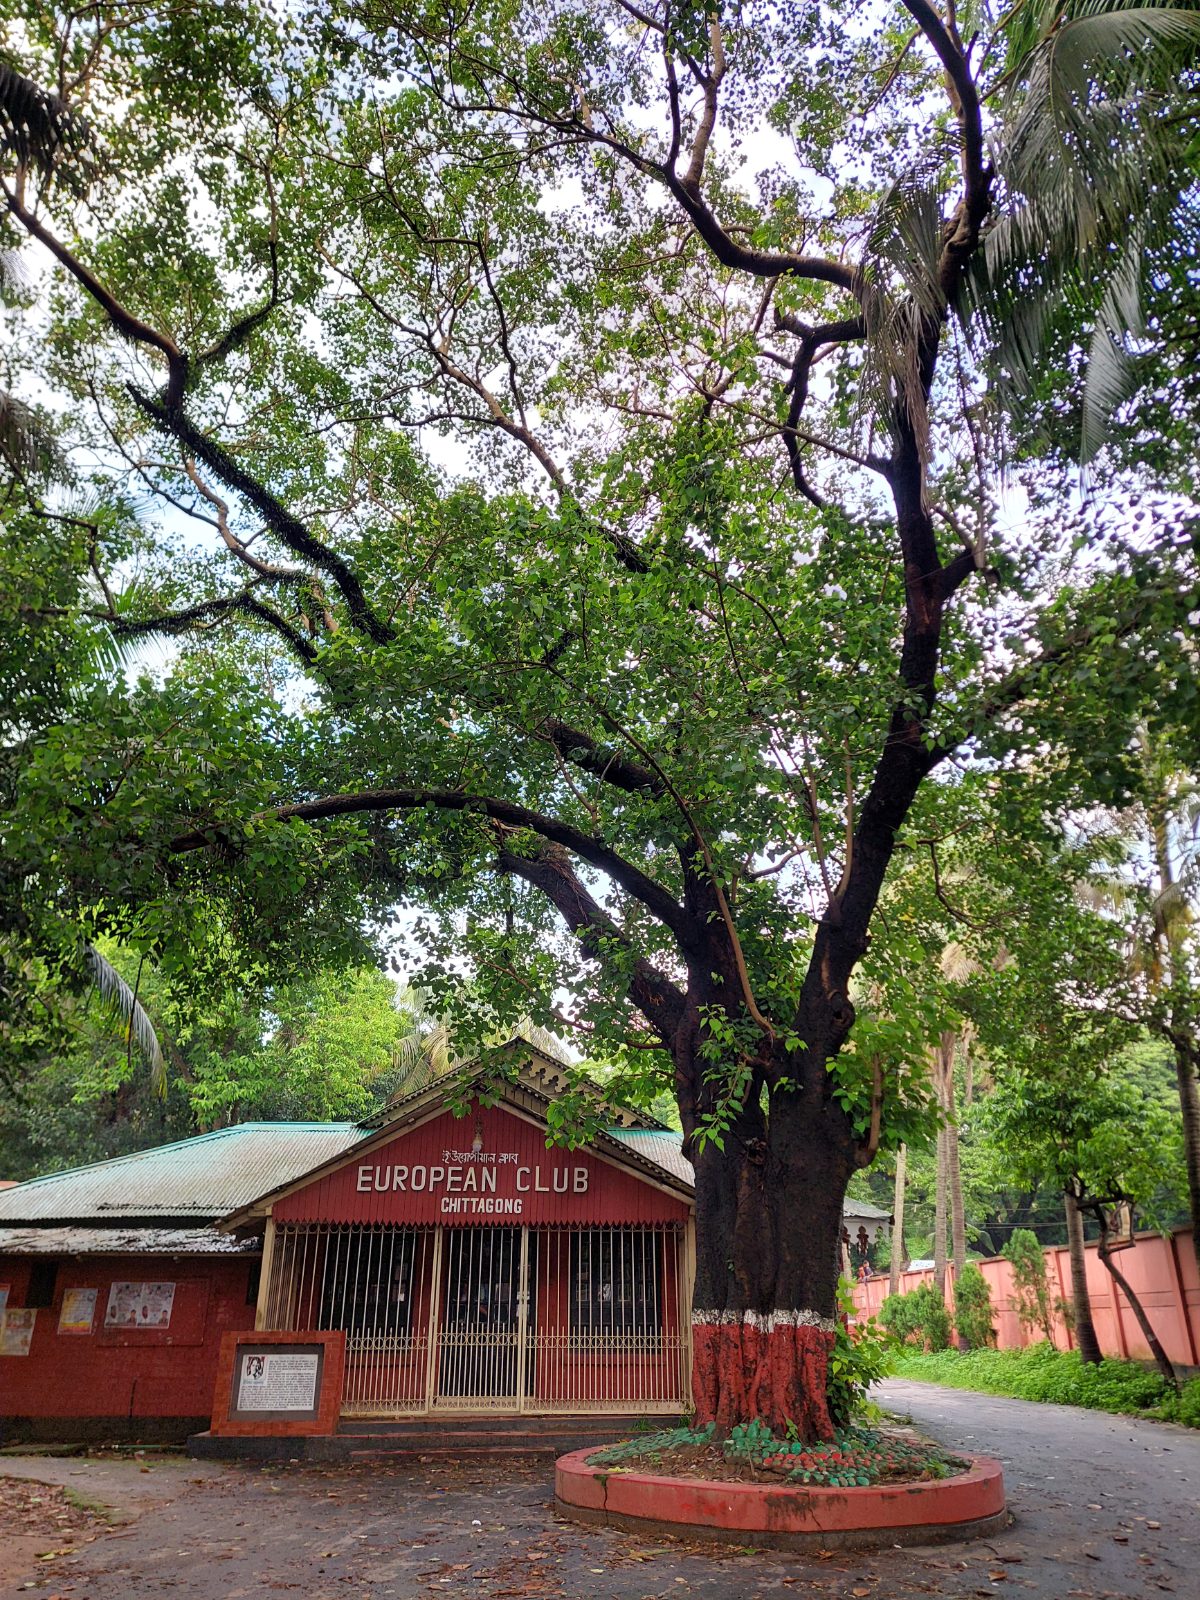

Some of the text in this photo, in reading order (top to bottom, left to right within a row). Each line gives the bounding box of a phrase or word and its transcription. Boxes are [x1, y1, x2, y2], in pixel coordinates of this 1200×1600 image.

[356, 1165, 589, 1193] EUROPEAN CLUB
[441, 1197, 522, 1214] CHITTAGONG
